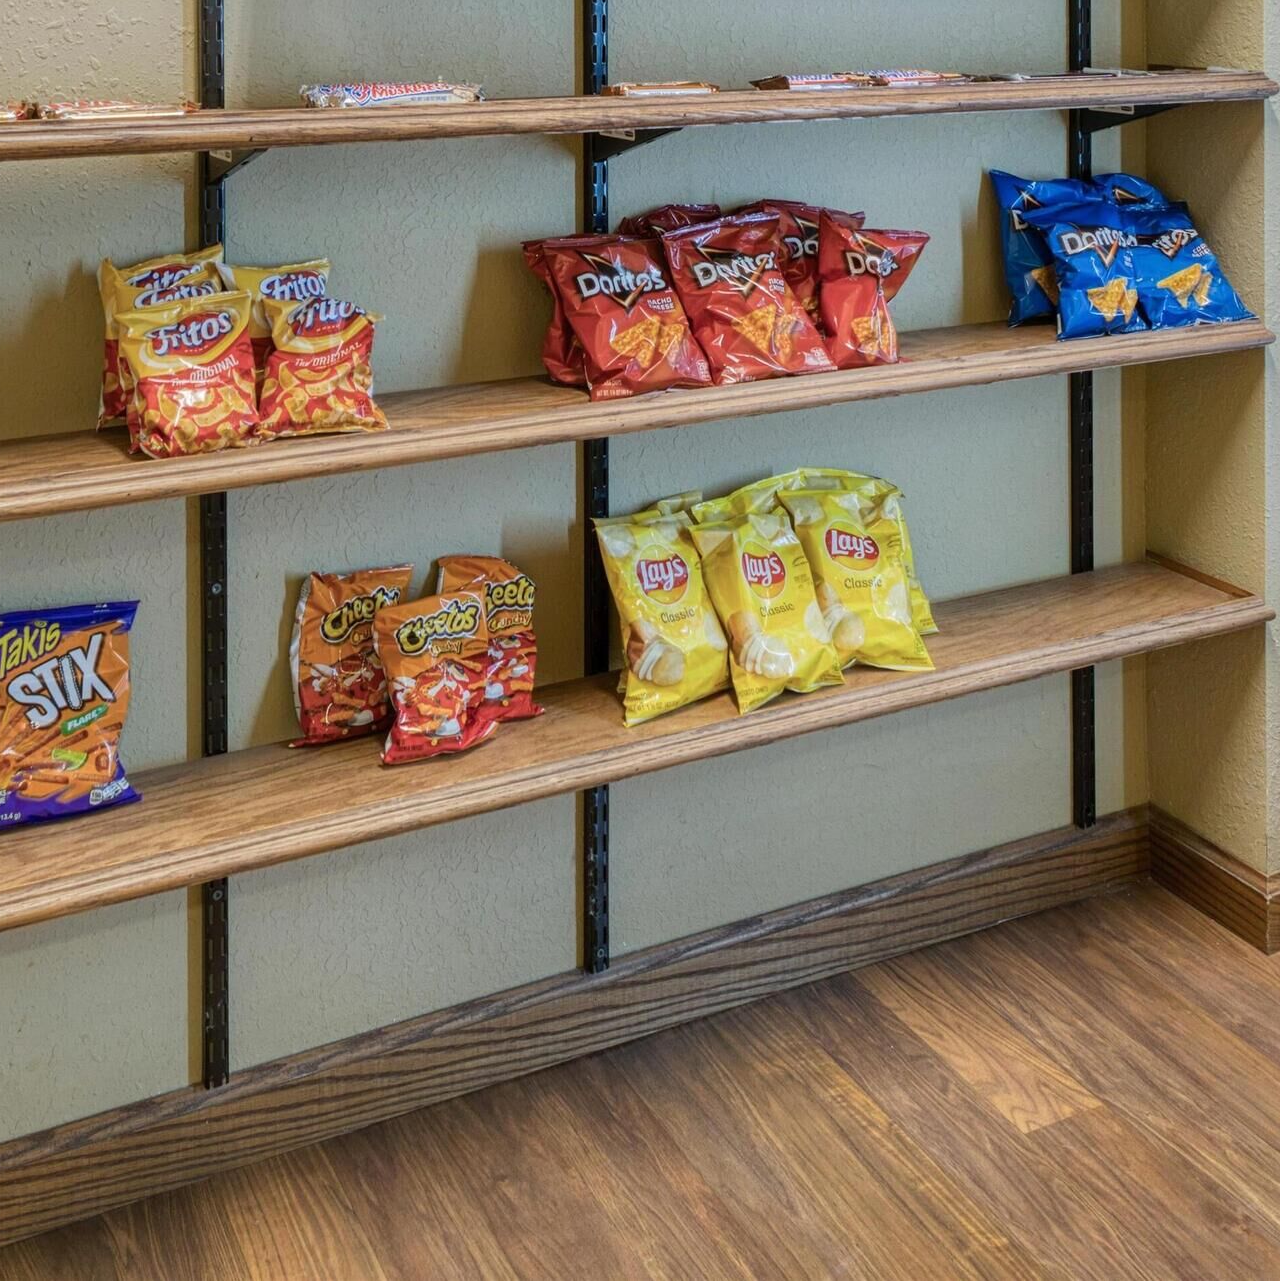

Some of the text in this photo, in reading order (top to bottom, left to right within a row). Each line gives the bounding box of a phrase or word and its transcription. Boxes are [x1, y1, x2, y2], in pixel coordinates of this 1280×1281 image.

[693, 251, 778, 287] Doritos
[577, 270, 669, 298] Doritos
[647, 296, 672, 307] NACHO
[146, 312, 234, 356] Fritos
[312, 341, 362, 366] ORIGINAL
[190, 354, 239, 382] ORIGINAL
[830, 529, 878, 559] Lay's
[639, 556, 686, 590] Lay's
[743, 552, 783, 587] Lay's
[844, 577, 883, 590] Classic
[488, 613, 531, 631] Crunchy
[660, 605, 695, 625] Classic
[759, 602, 795, 617] Classic
[397, 601, 477, 653] Cheetos
[430, 640, 462, 654] Crunchy
[7, 632, 116, 729] STIX
[67, 710, 98, 731] FLARE
